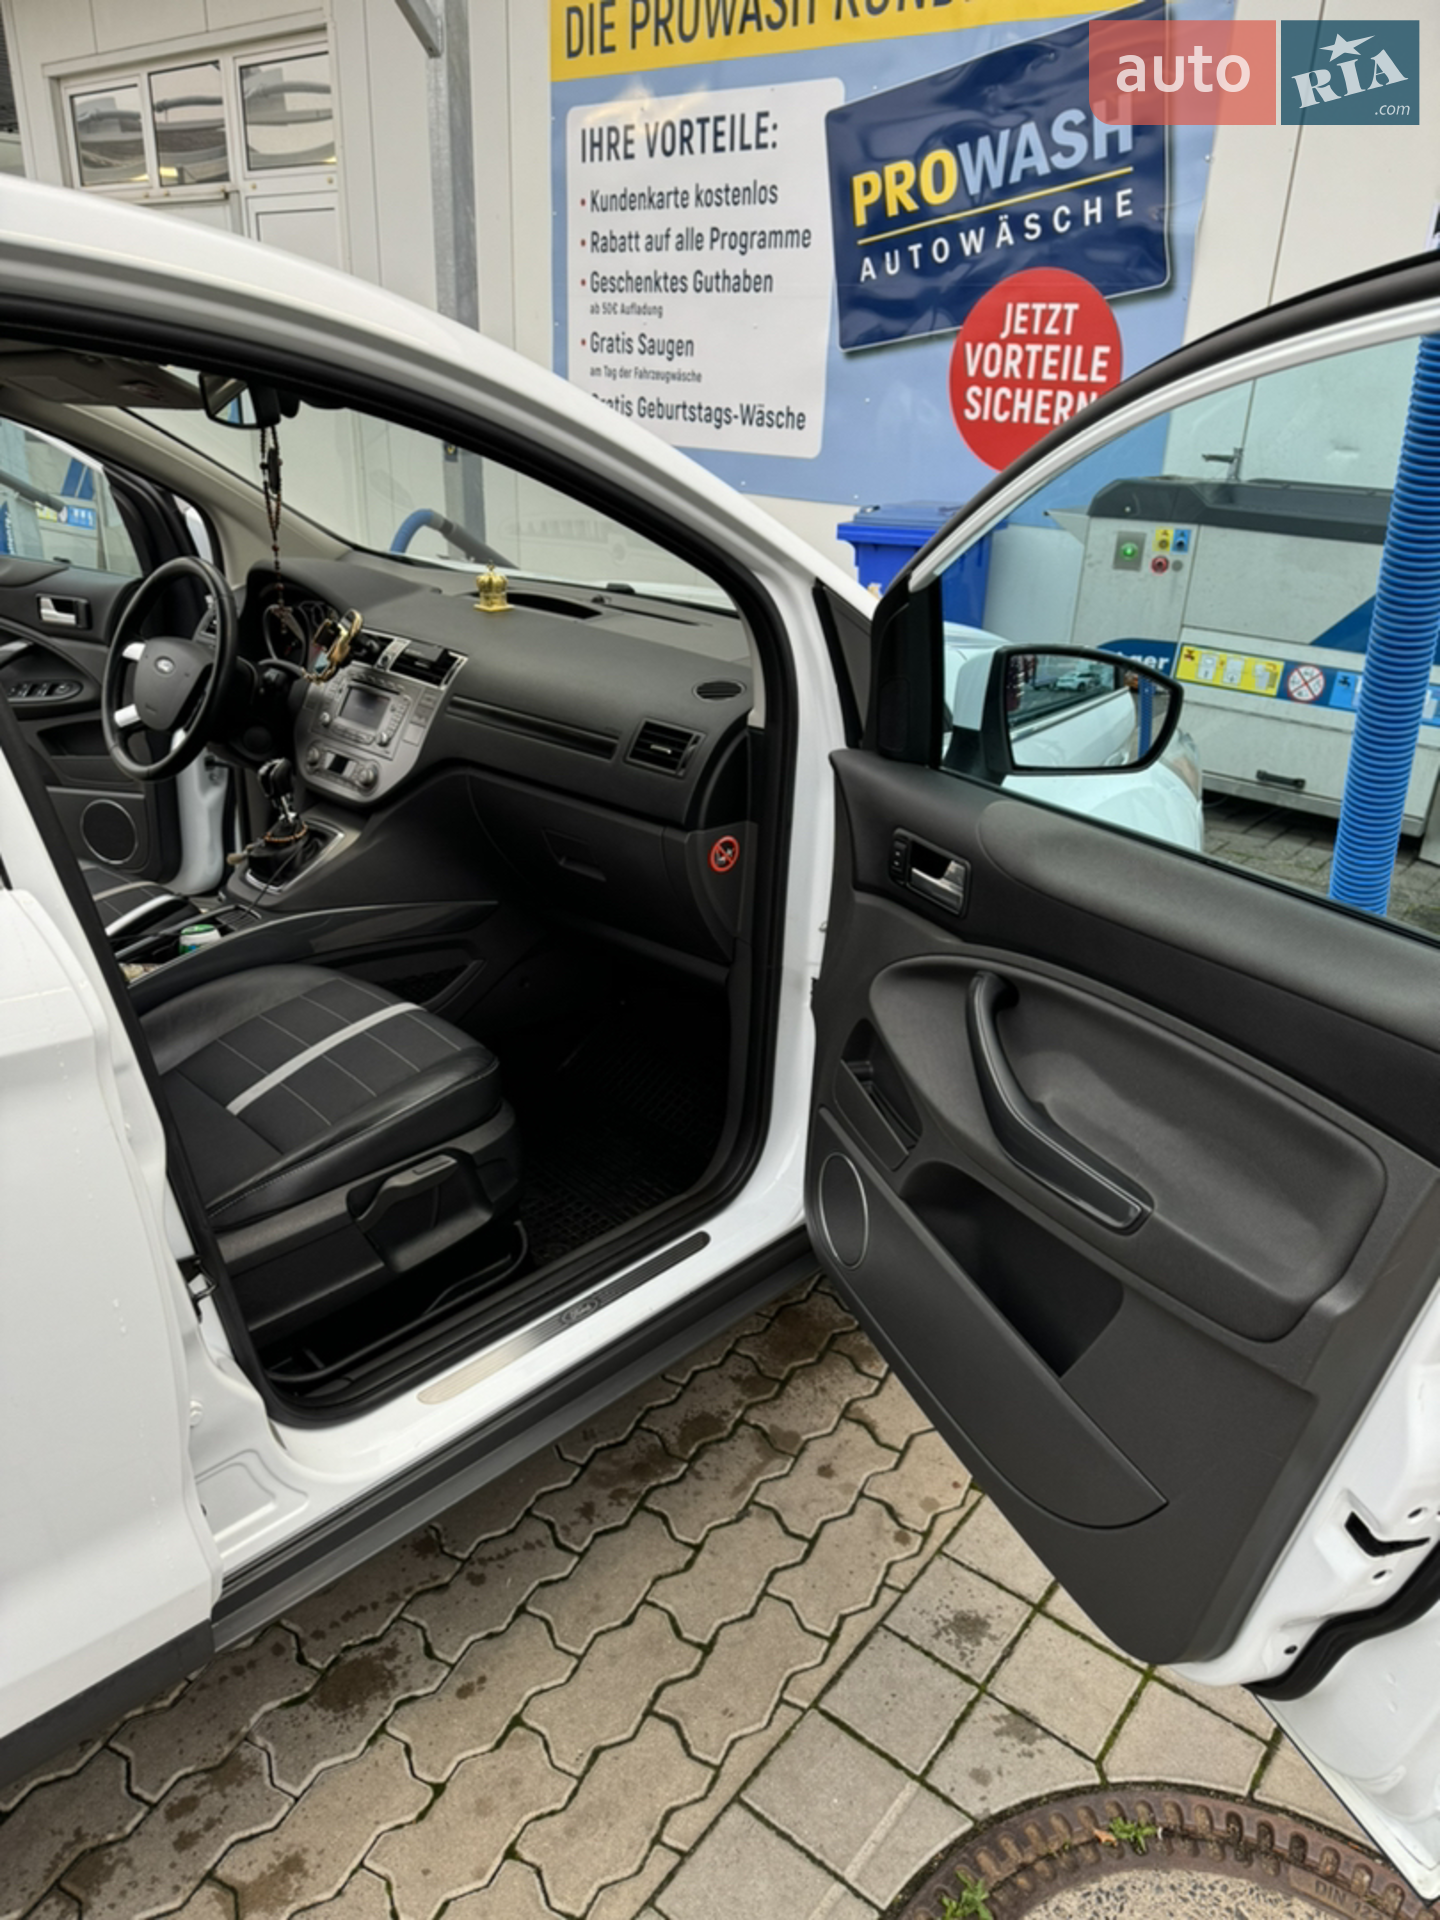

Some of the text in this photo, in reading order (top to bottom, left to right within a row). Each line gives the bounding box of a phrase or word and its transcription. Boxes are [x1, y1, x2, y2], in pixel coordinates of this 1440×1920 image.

[566, 0, 616, 59] DIE
[581, 111, 778, 163] IHRE VORTEILE:
[852, 92, 1133, 227] PROWASH
[590, 179, 778, 213] Kundenkarte kostenlos
[590, 226, 812, 256] Rabatt auf alle Programme
[860, 188, 1133, 283] AUTOWÄSCHE
[590, 268, 773, 293] Geschenktes Guthaben
[589, 302, 600, 315] ab
[620, 302, 664, 319] Aufladung
[1000, 302, 1080, 339] JETZT
[590, 331, 694, 361] Gratis Saugen
[964, 342, 1111, 382] VORTEILE
[590, 365, 702, 384] am Tag der Fahrzeugwäsche
[637, 396, 806, 430] Geburtstags-Wäsche
[1315, 1880, 1346, 1905] DIN
